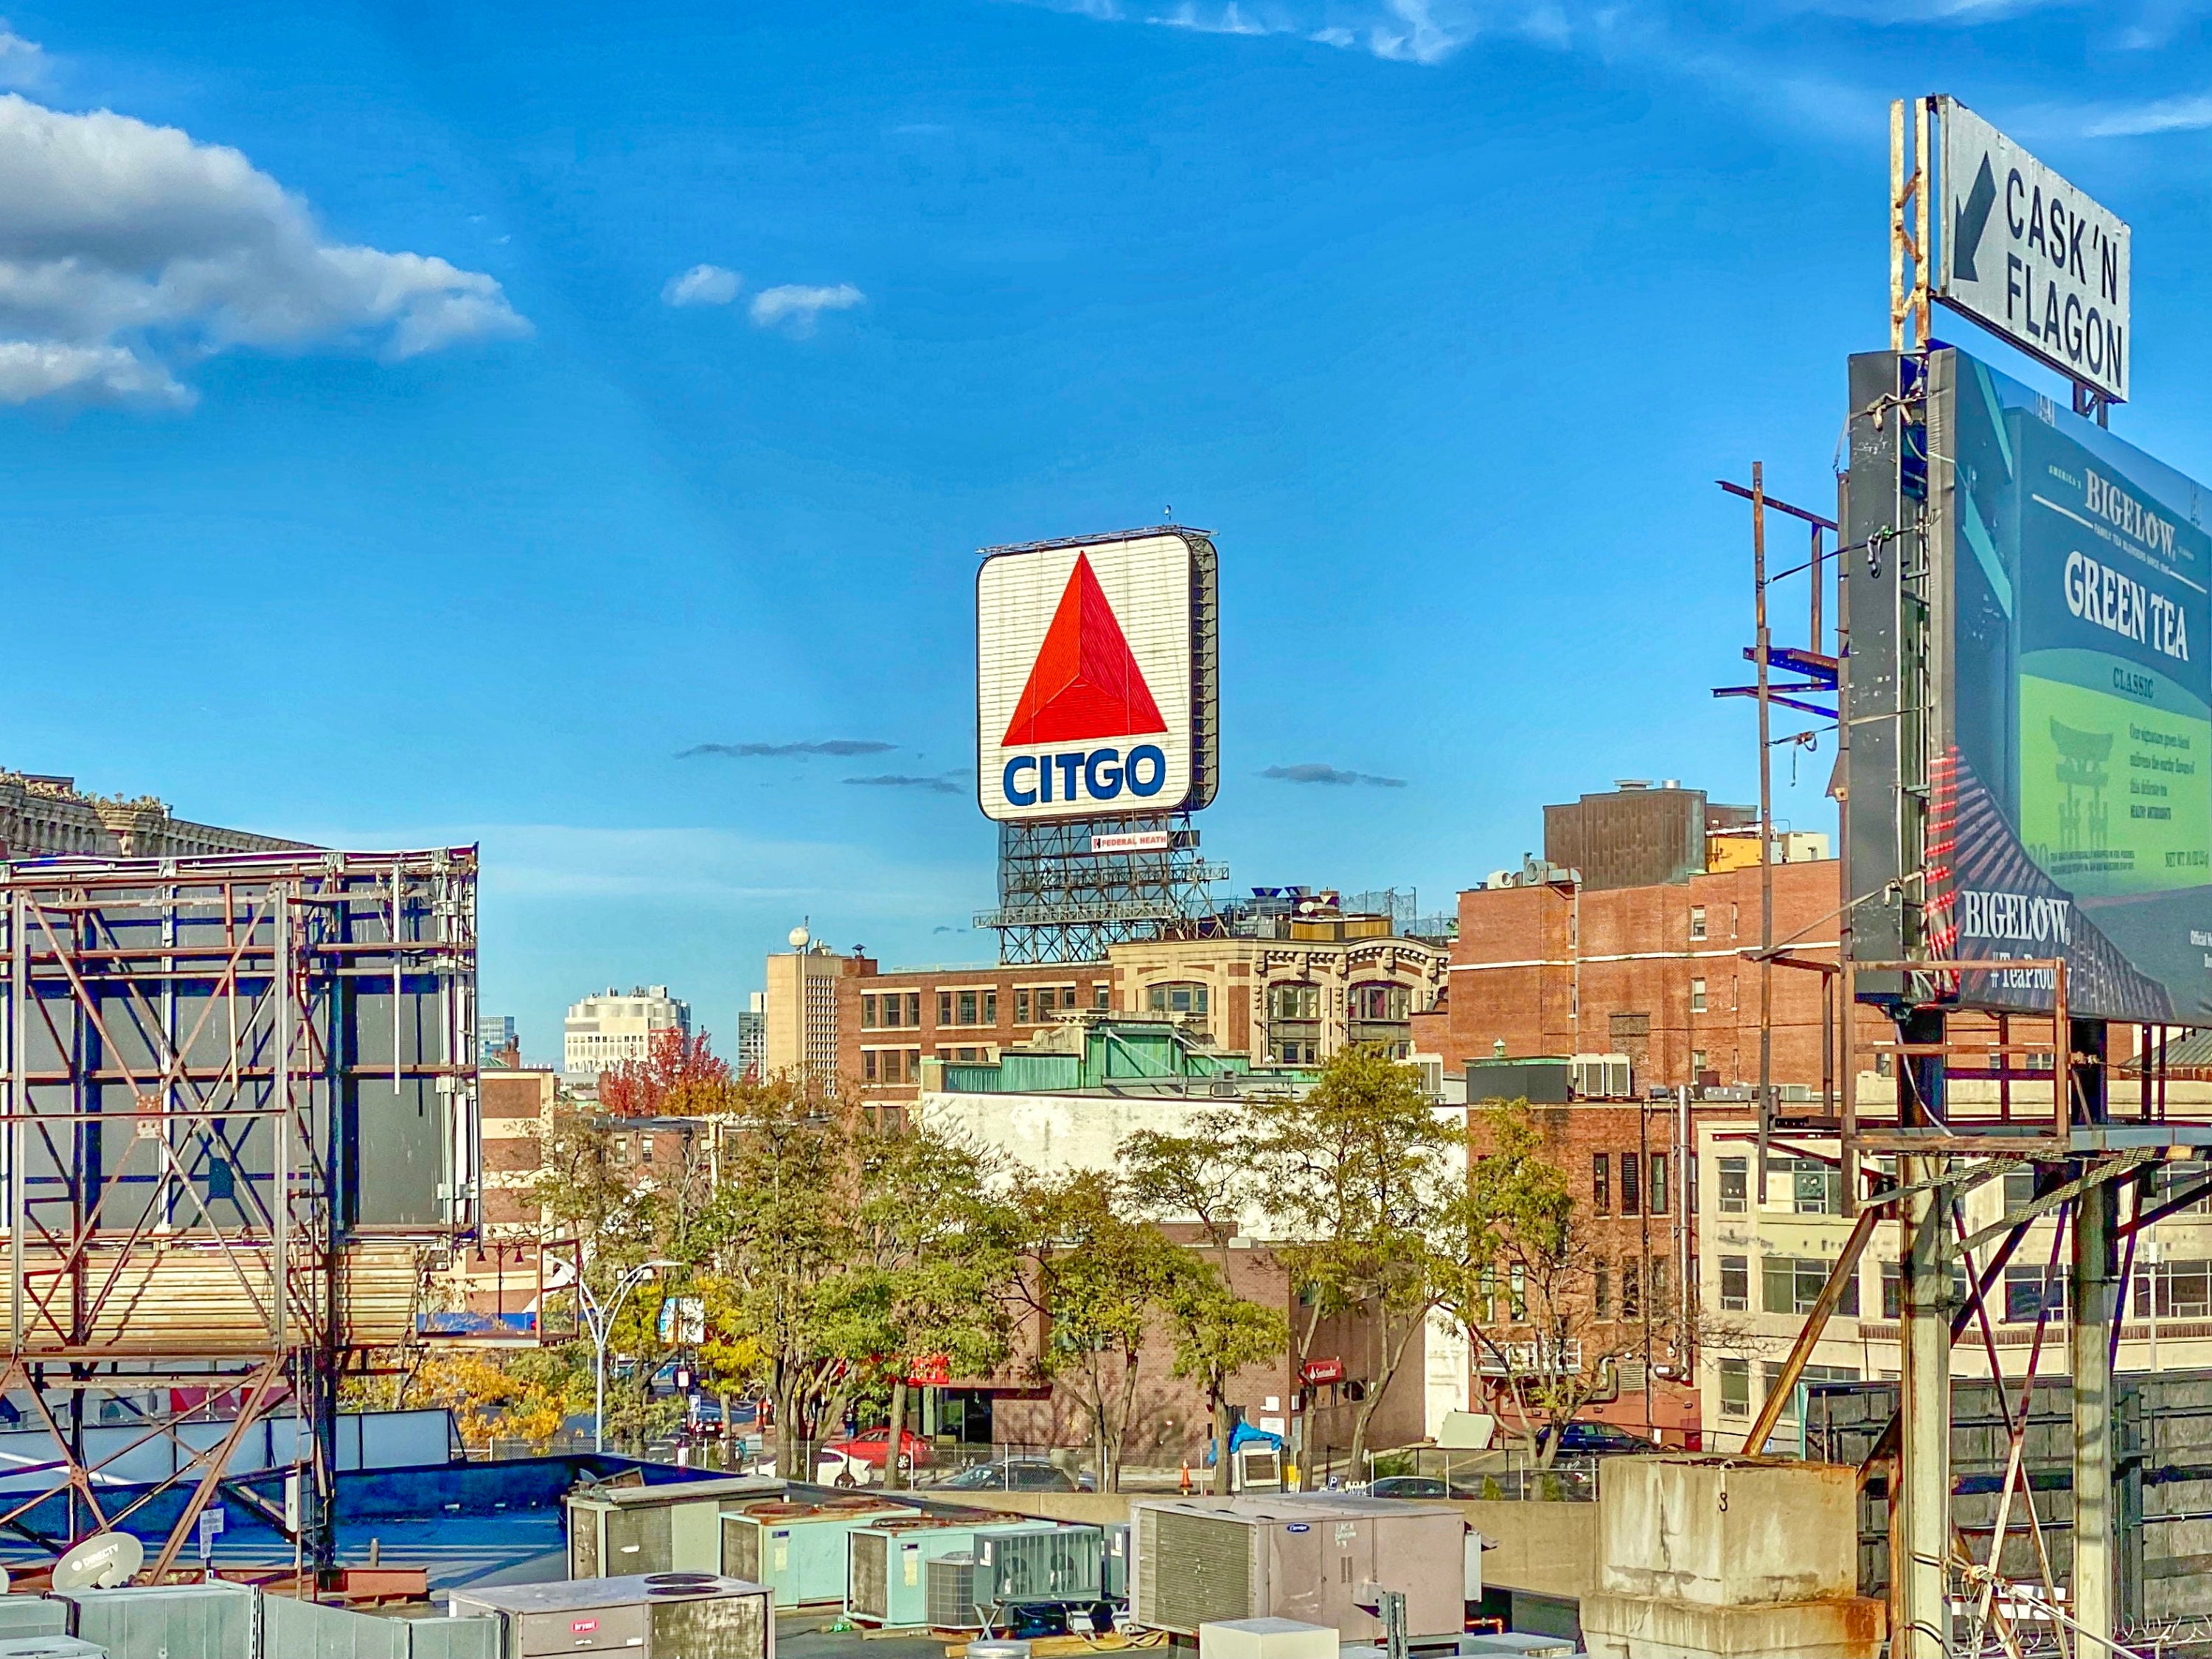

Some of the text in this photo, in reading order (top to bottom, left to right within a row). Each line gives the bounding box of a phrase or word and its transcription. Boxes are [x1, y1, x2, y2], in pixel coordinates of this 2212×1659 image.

[2006, 168, 2117, 305] CASK 'N
[2007, 251, 2122, 388] FLAGON
[2084, 467, 2175, 558] BIGELOW
[2065, 551, 2189, 661] GREEN TEA
[2112, 667, 2154, 698] CLASSIC
[1003, 744, 1166, 806] CITGO
[1102, 835, 1166, 847] FEDERAL HEATH
[1962, 891, 2070, 944] BIGELOW
[1991, 951, 2073, 998] #TeaProuy
[1315, 1366, 1337, 1378] Santander
[1329, 1476, 1338, 1489] P
[83, 1543, 118, 1568] DIRECTV
